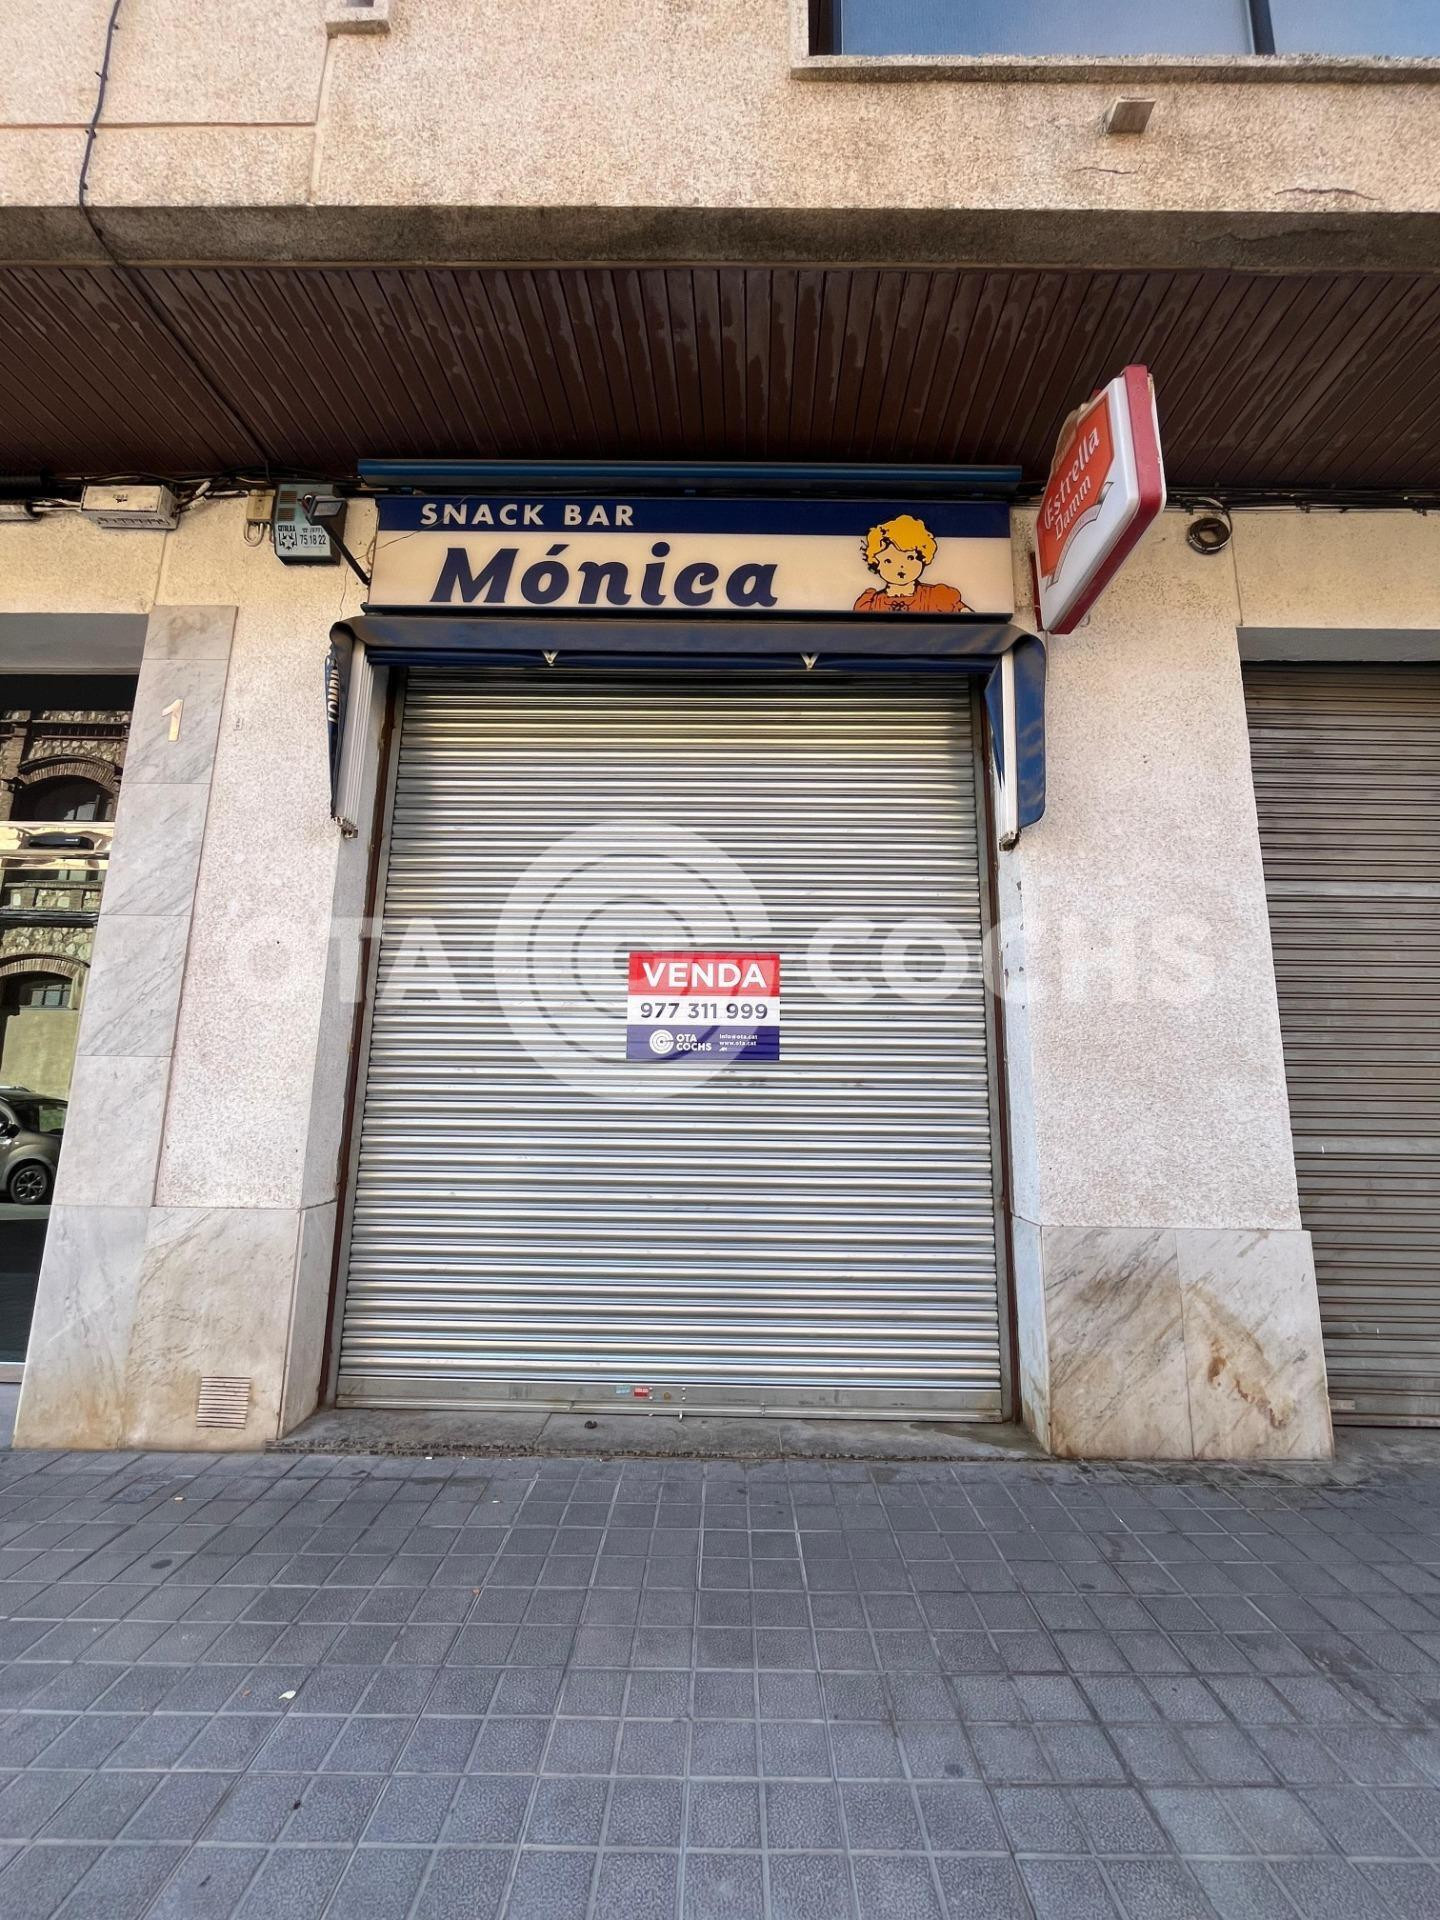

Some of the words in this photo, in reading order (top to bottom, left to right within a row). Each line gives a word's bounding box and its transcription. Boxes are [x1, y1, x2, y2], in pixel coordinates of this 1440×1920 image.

[1043, 426, 1100, 531] Estrella
[420, 503, 545, 527] SNACK
[563, 504, 635, 528] BAR
[1054, 475, 1092, 541] Damm
[430, 541, 778, 608] Mónica
[161, 699, 183, 743] 1
[642, 962, 767, 988] VENDA
[640, 1002, 680, 1019] 977
[687, 1002, 718, 1019] 311
[726, 1002, 768, 1020] 999
[676, 1033, 698, 1043] OTA
[676, 1042, 712, 1052] COCHS
